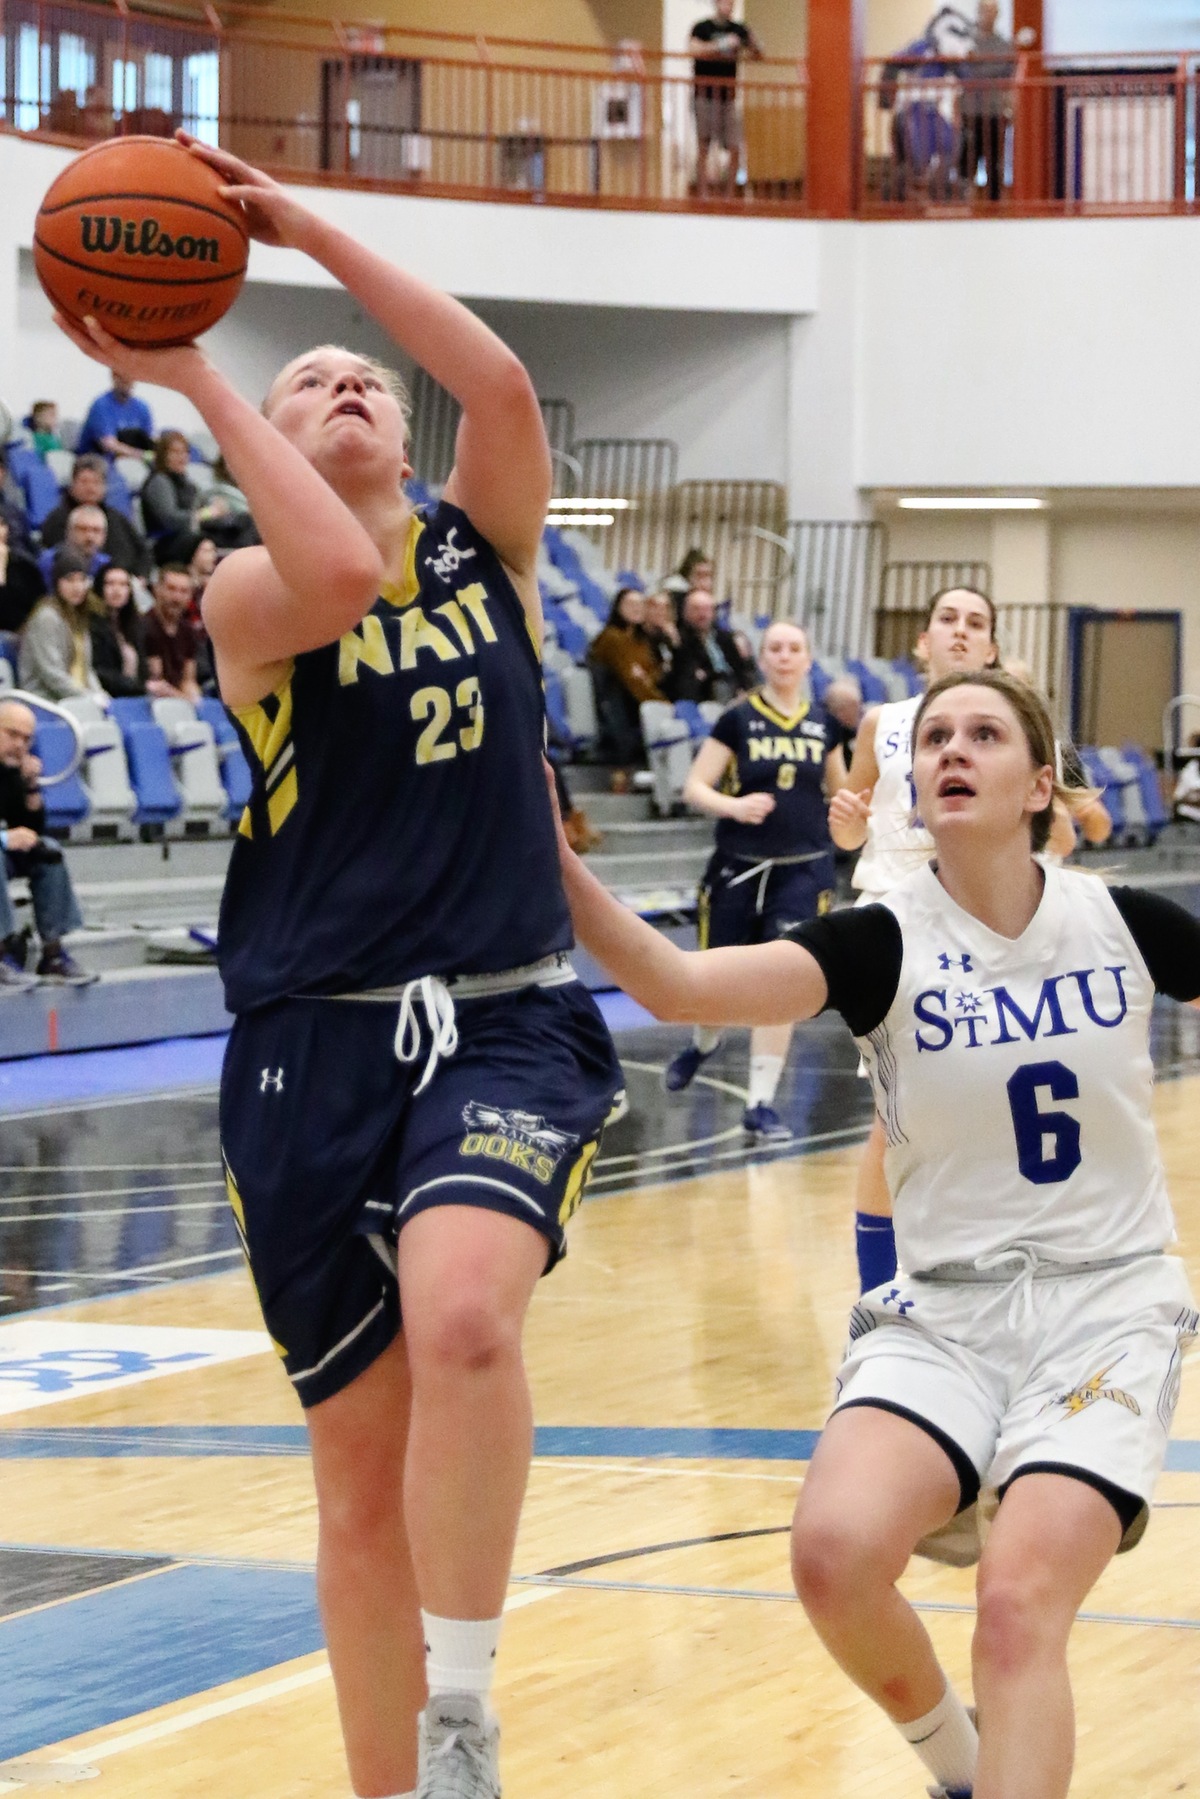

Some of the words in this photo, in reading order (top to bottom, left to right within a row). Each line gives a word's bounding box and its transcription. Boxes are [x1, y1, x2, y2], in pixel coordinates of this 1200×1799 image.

[80, 215, 220, 263] Wilson
[77, 287, 213, 322] EVOLUTION
[338, 582, 498, 686] NAIT
[410, 676, 484, 765] 23
[747, 736, 825, 764] NAIT
[1006, 1060, 1082, 1185] 6
[459, 1133, 556, 1185] OOKS
